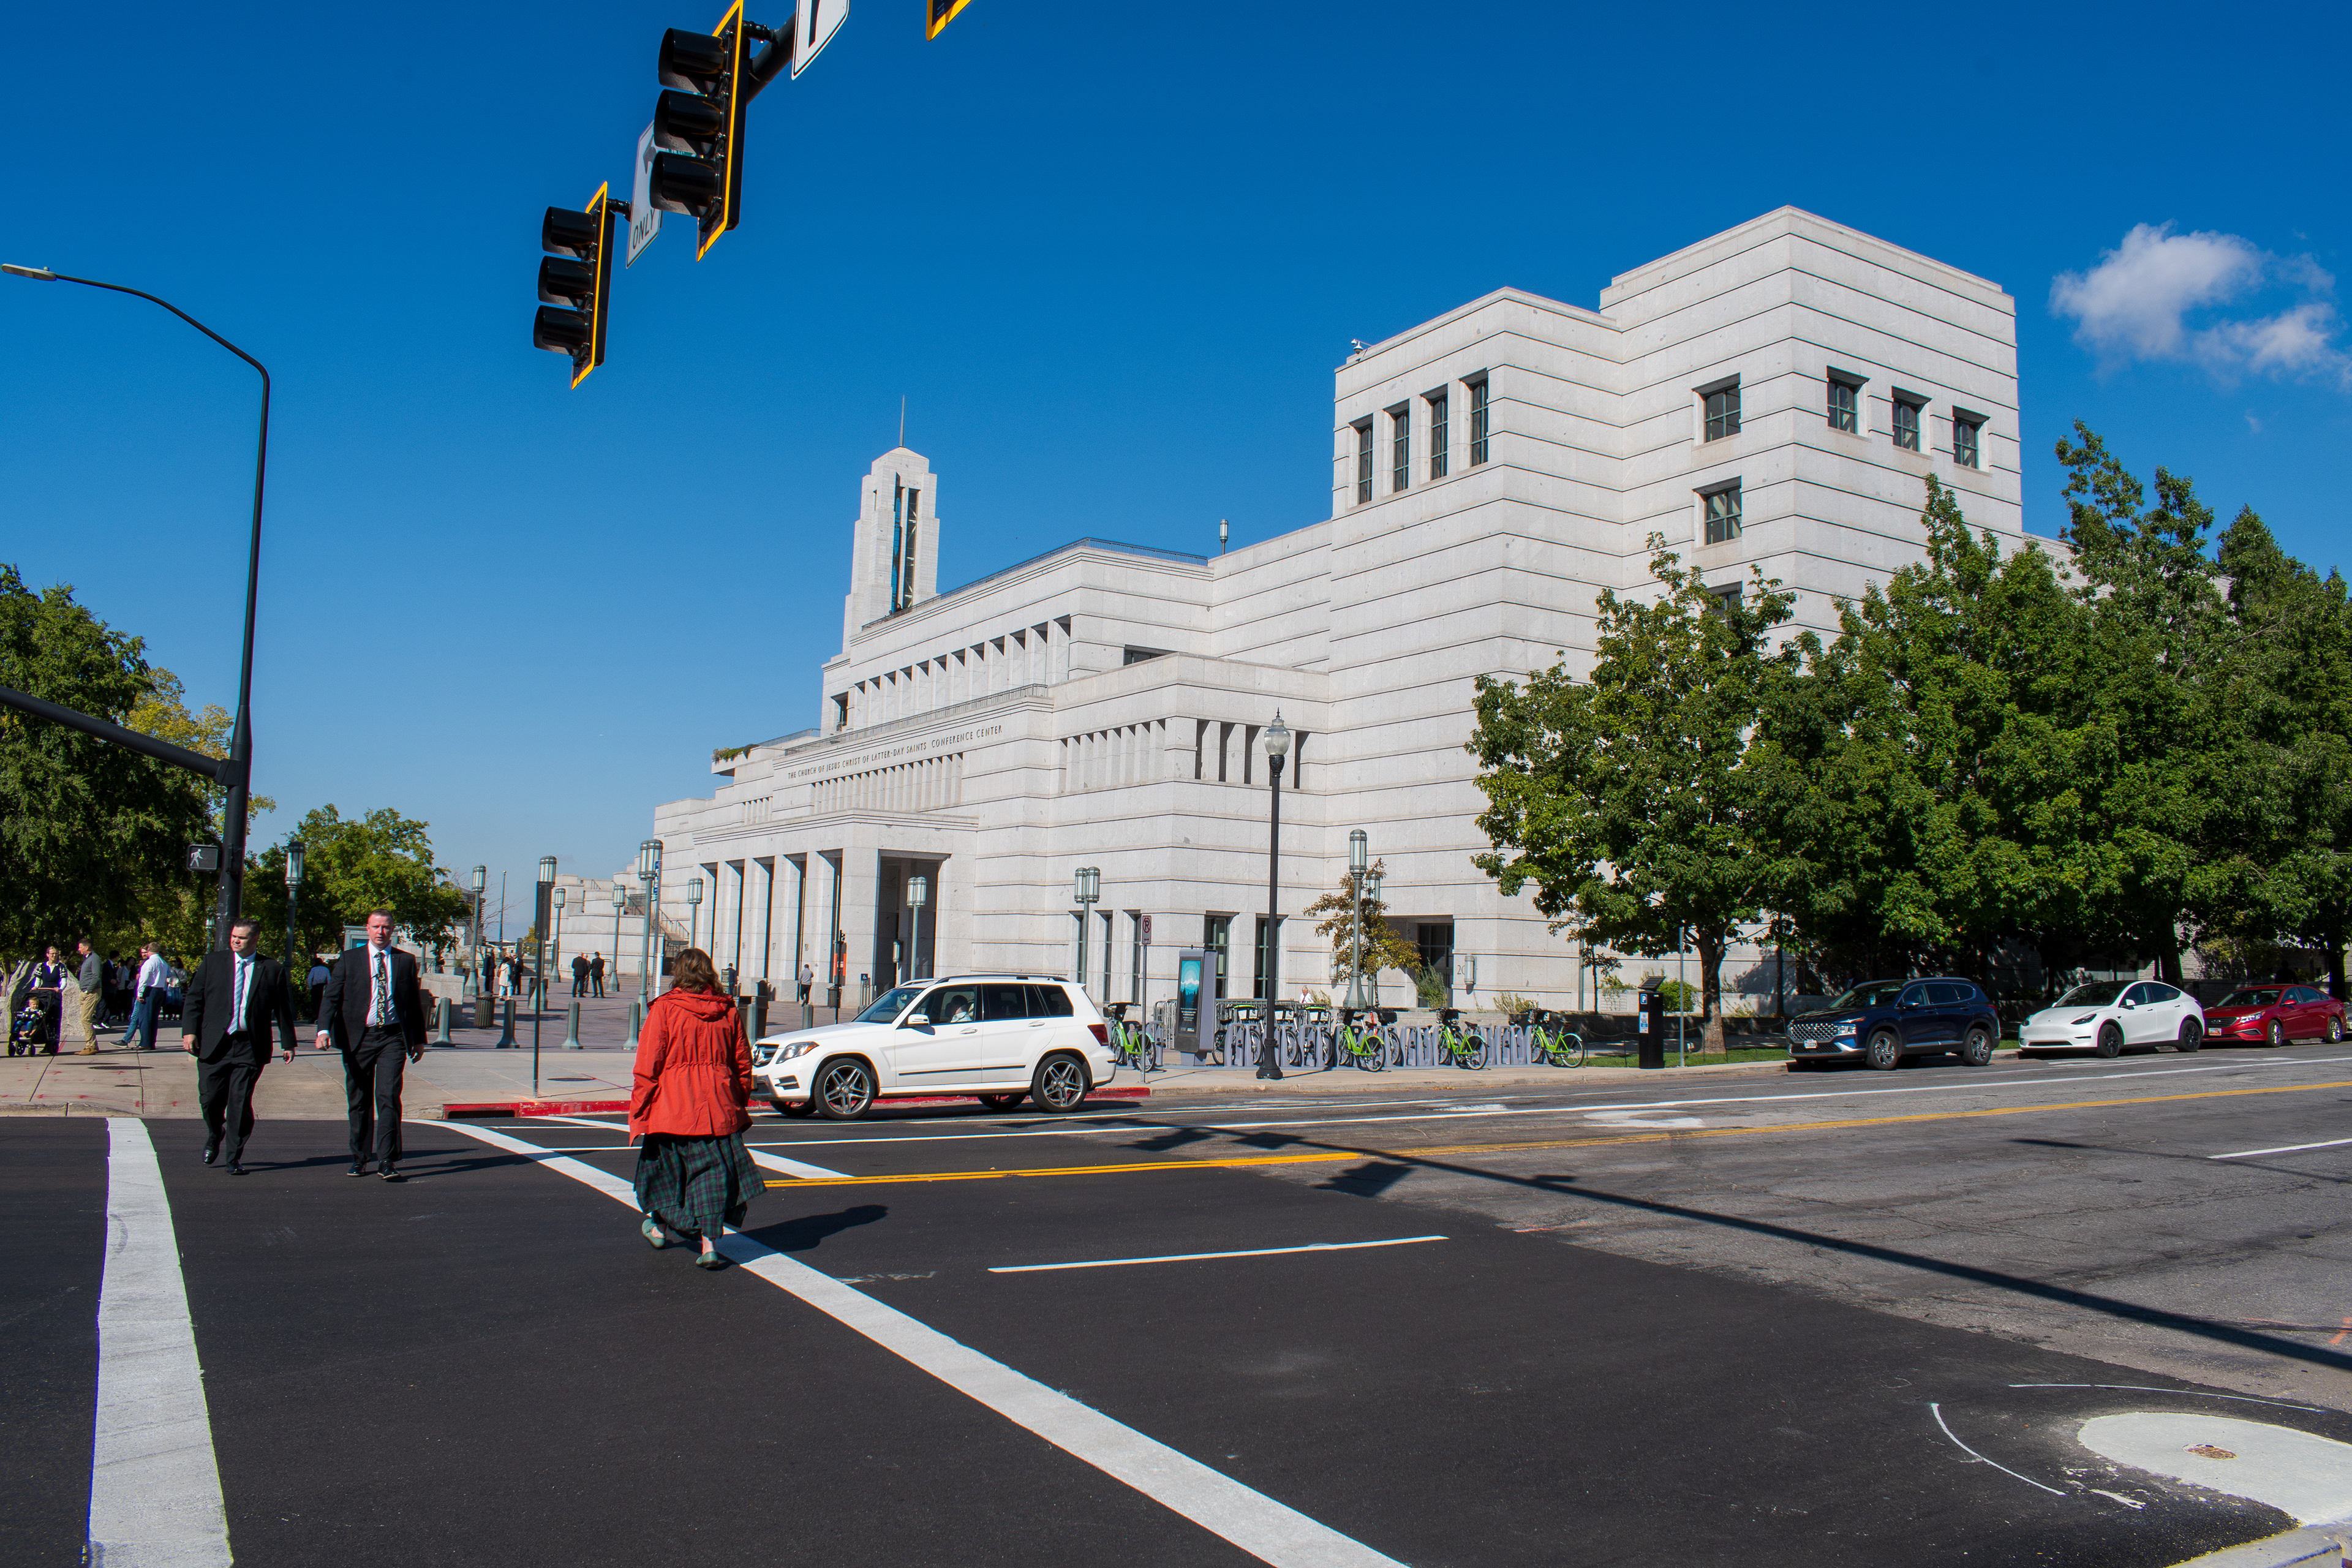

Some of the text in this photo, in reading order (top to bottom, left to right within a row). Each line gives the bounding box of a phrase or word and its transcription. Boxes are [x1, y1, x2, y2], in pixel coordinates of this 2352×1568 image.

[633, 209, 655, 250] ONLY
[798, 767, 816, 777] CHURCH
[826, 762, 840, 772] JESUS
[842, 757, 861, 767] CHRIST
[872, 747, 905, 761] LATTER-DAY
[907, 742, 927, 753] SAINTS
[932, 731, 973, 748] CONFERENCE
[976, 725, 1003, 738] CENTER
